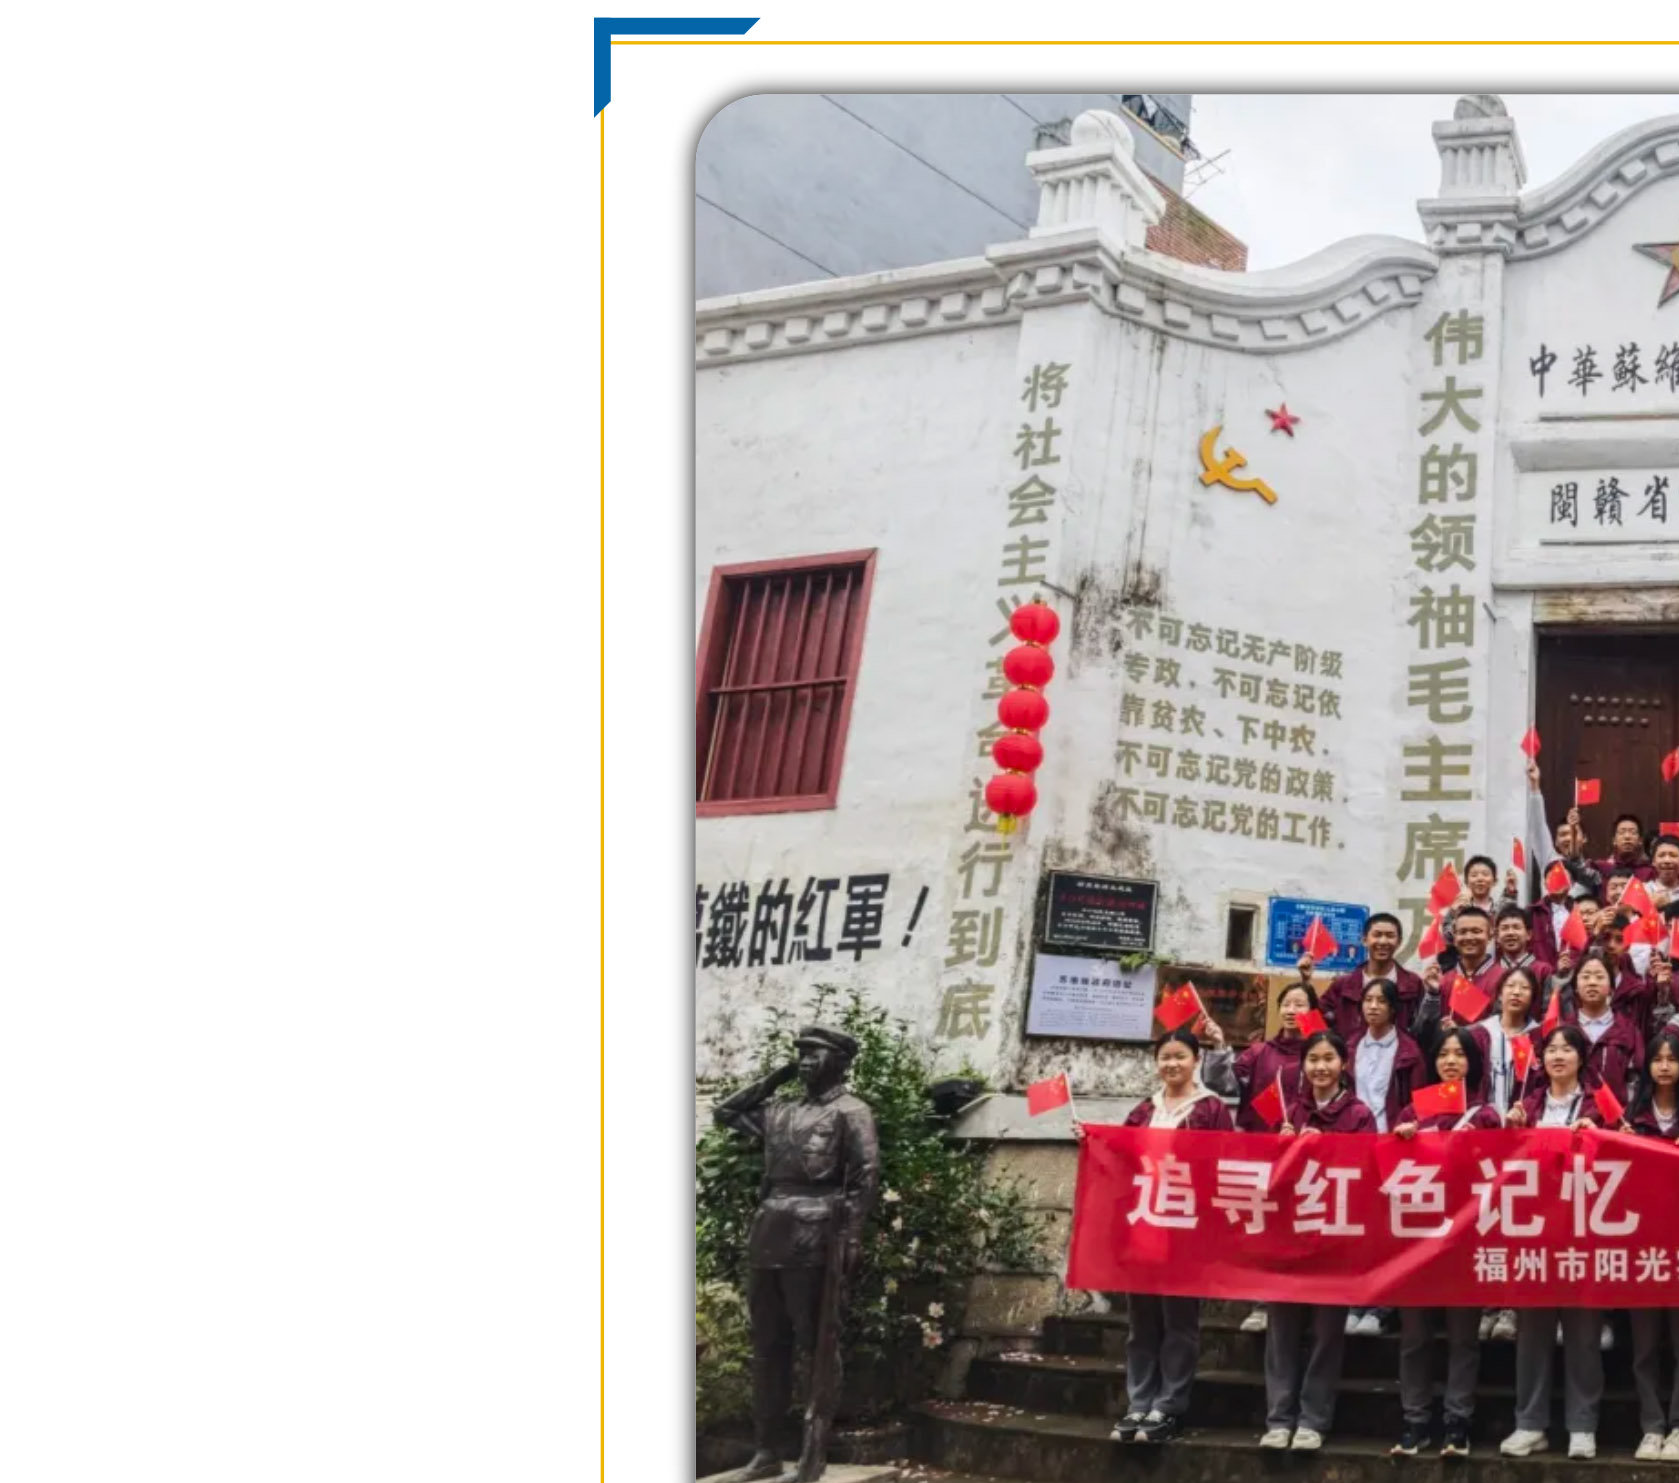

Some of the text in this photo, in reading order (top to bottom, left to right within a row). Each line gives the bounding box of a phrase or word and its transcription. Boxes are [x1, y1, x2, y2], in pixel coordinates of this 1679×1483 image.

[1126, 606, 1344, 679] 不可忘记无产阶级
[1126, 1153, 1641, 1238] 追寻红色记忆
